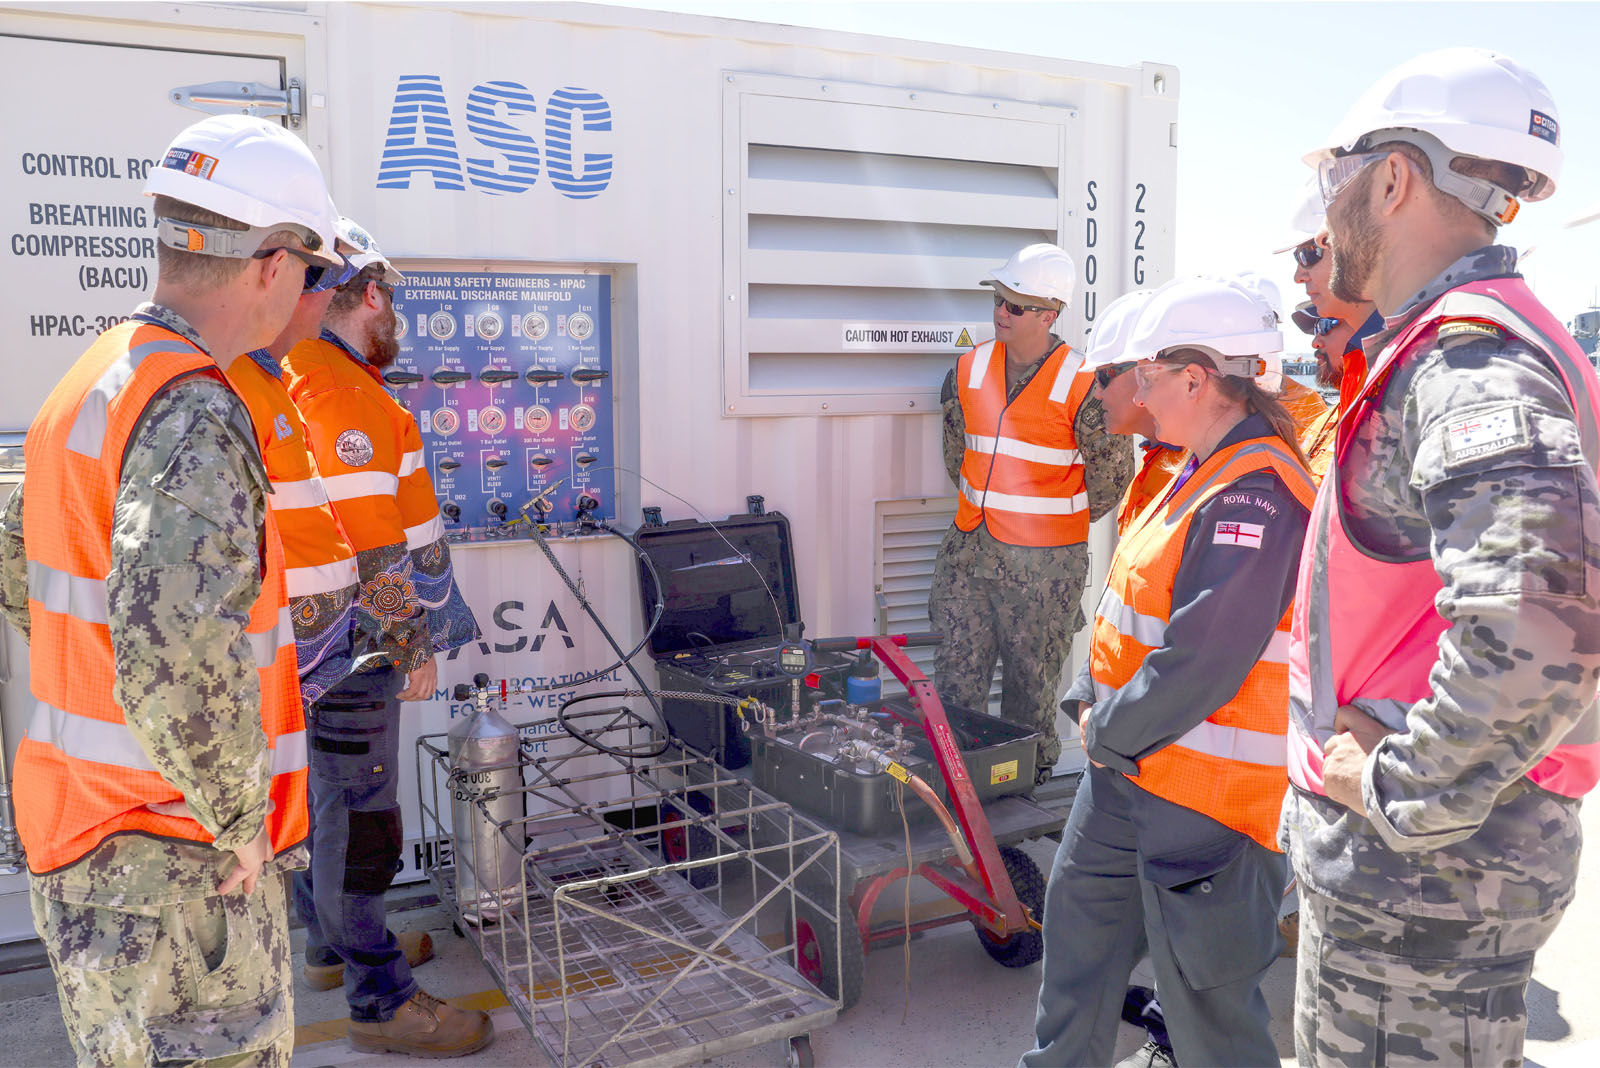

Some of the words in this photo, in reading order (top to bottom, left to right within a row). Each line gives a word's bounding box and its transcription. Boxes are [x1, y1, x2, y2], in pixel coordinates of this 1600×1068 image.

[376, 75, 613, 199] ASC
[22, 153, 121, 178] CONTROL
[29, 203, 147, 228] BREATHING
[11, 234, 155, 258] COMPRESSOR
[79, 265, 147, 291] (BACU)
[454, 278, 491, 288] SAFETY
[495, 278, 550, 288] ENGINEERS
[560, 280, 586, 289] HPAC
[405, 289, 458, 300] EXTERNAL
[461, 290, 518, 301] DISCHARGE
[521, 291, 571, 301] MANIFOLD
[845, 330, 888, 343] CAUTION
[890, 330, 908, 342] HOT
[911, 331, 953, 343] EXHAUST
[1447, 325, 1498, 335] AUSTRALIA
[1456, 437, 1515, 460] AUSTRALIA
[1224, 495, 1251, 505] ROYAL
[1255, 498, 1276, 516] NAVY
